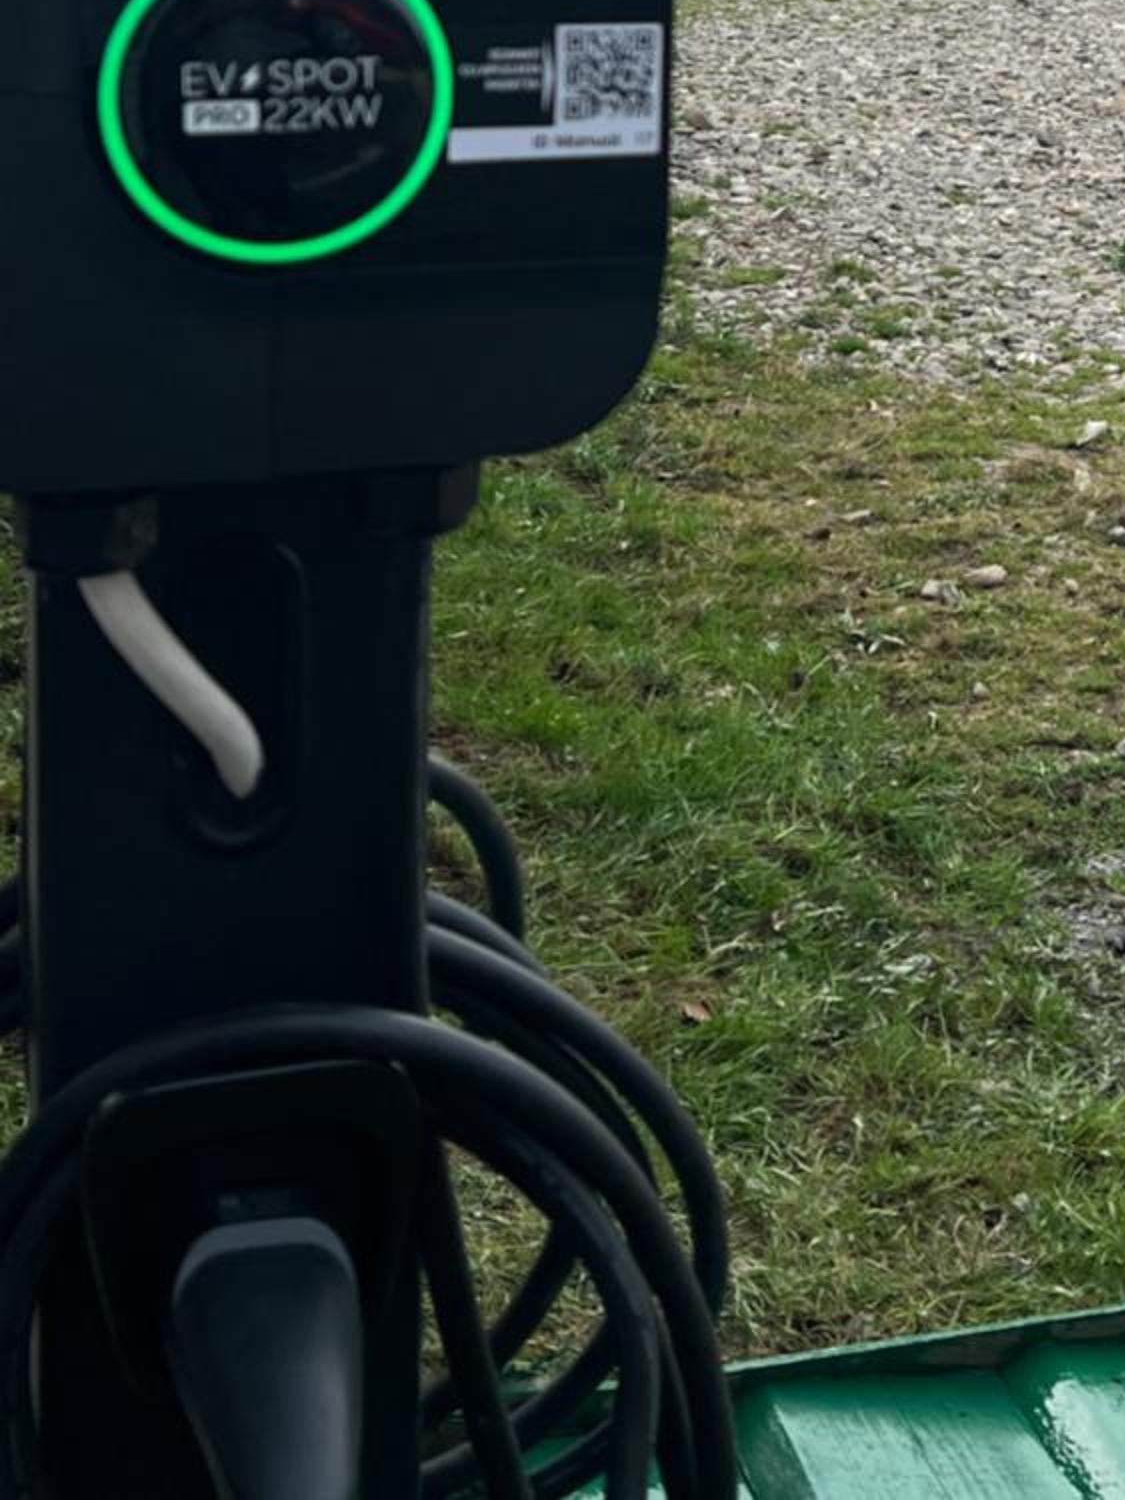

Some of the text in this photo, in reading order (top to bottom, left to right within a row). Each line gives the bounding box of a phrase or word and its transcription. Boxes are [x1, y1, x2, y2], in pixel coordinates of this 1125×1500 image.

[179, 54, 382, 98] EV SPOT
[262, 94, 384, 132] 22KW
